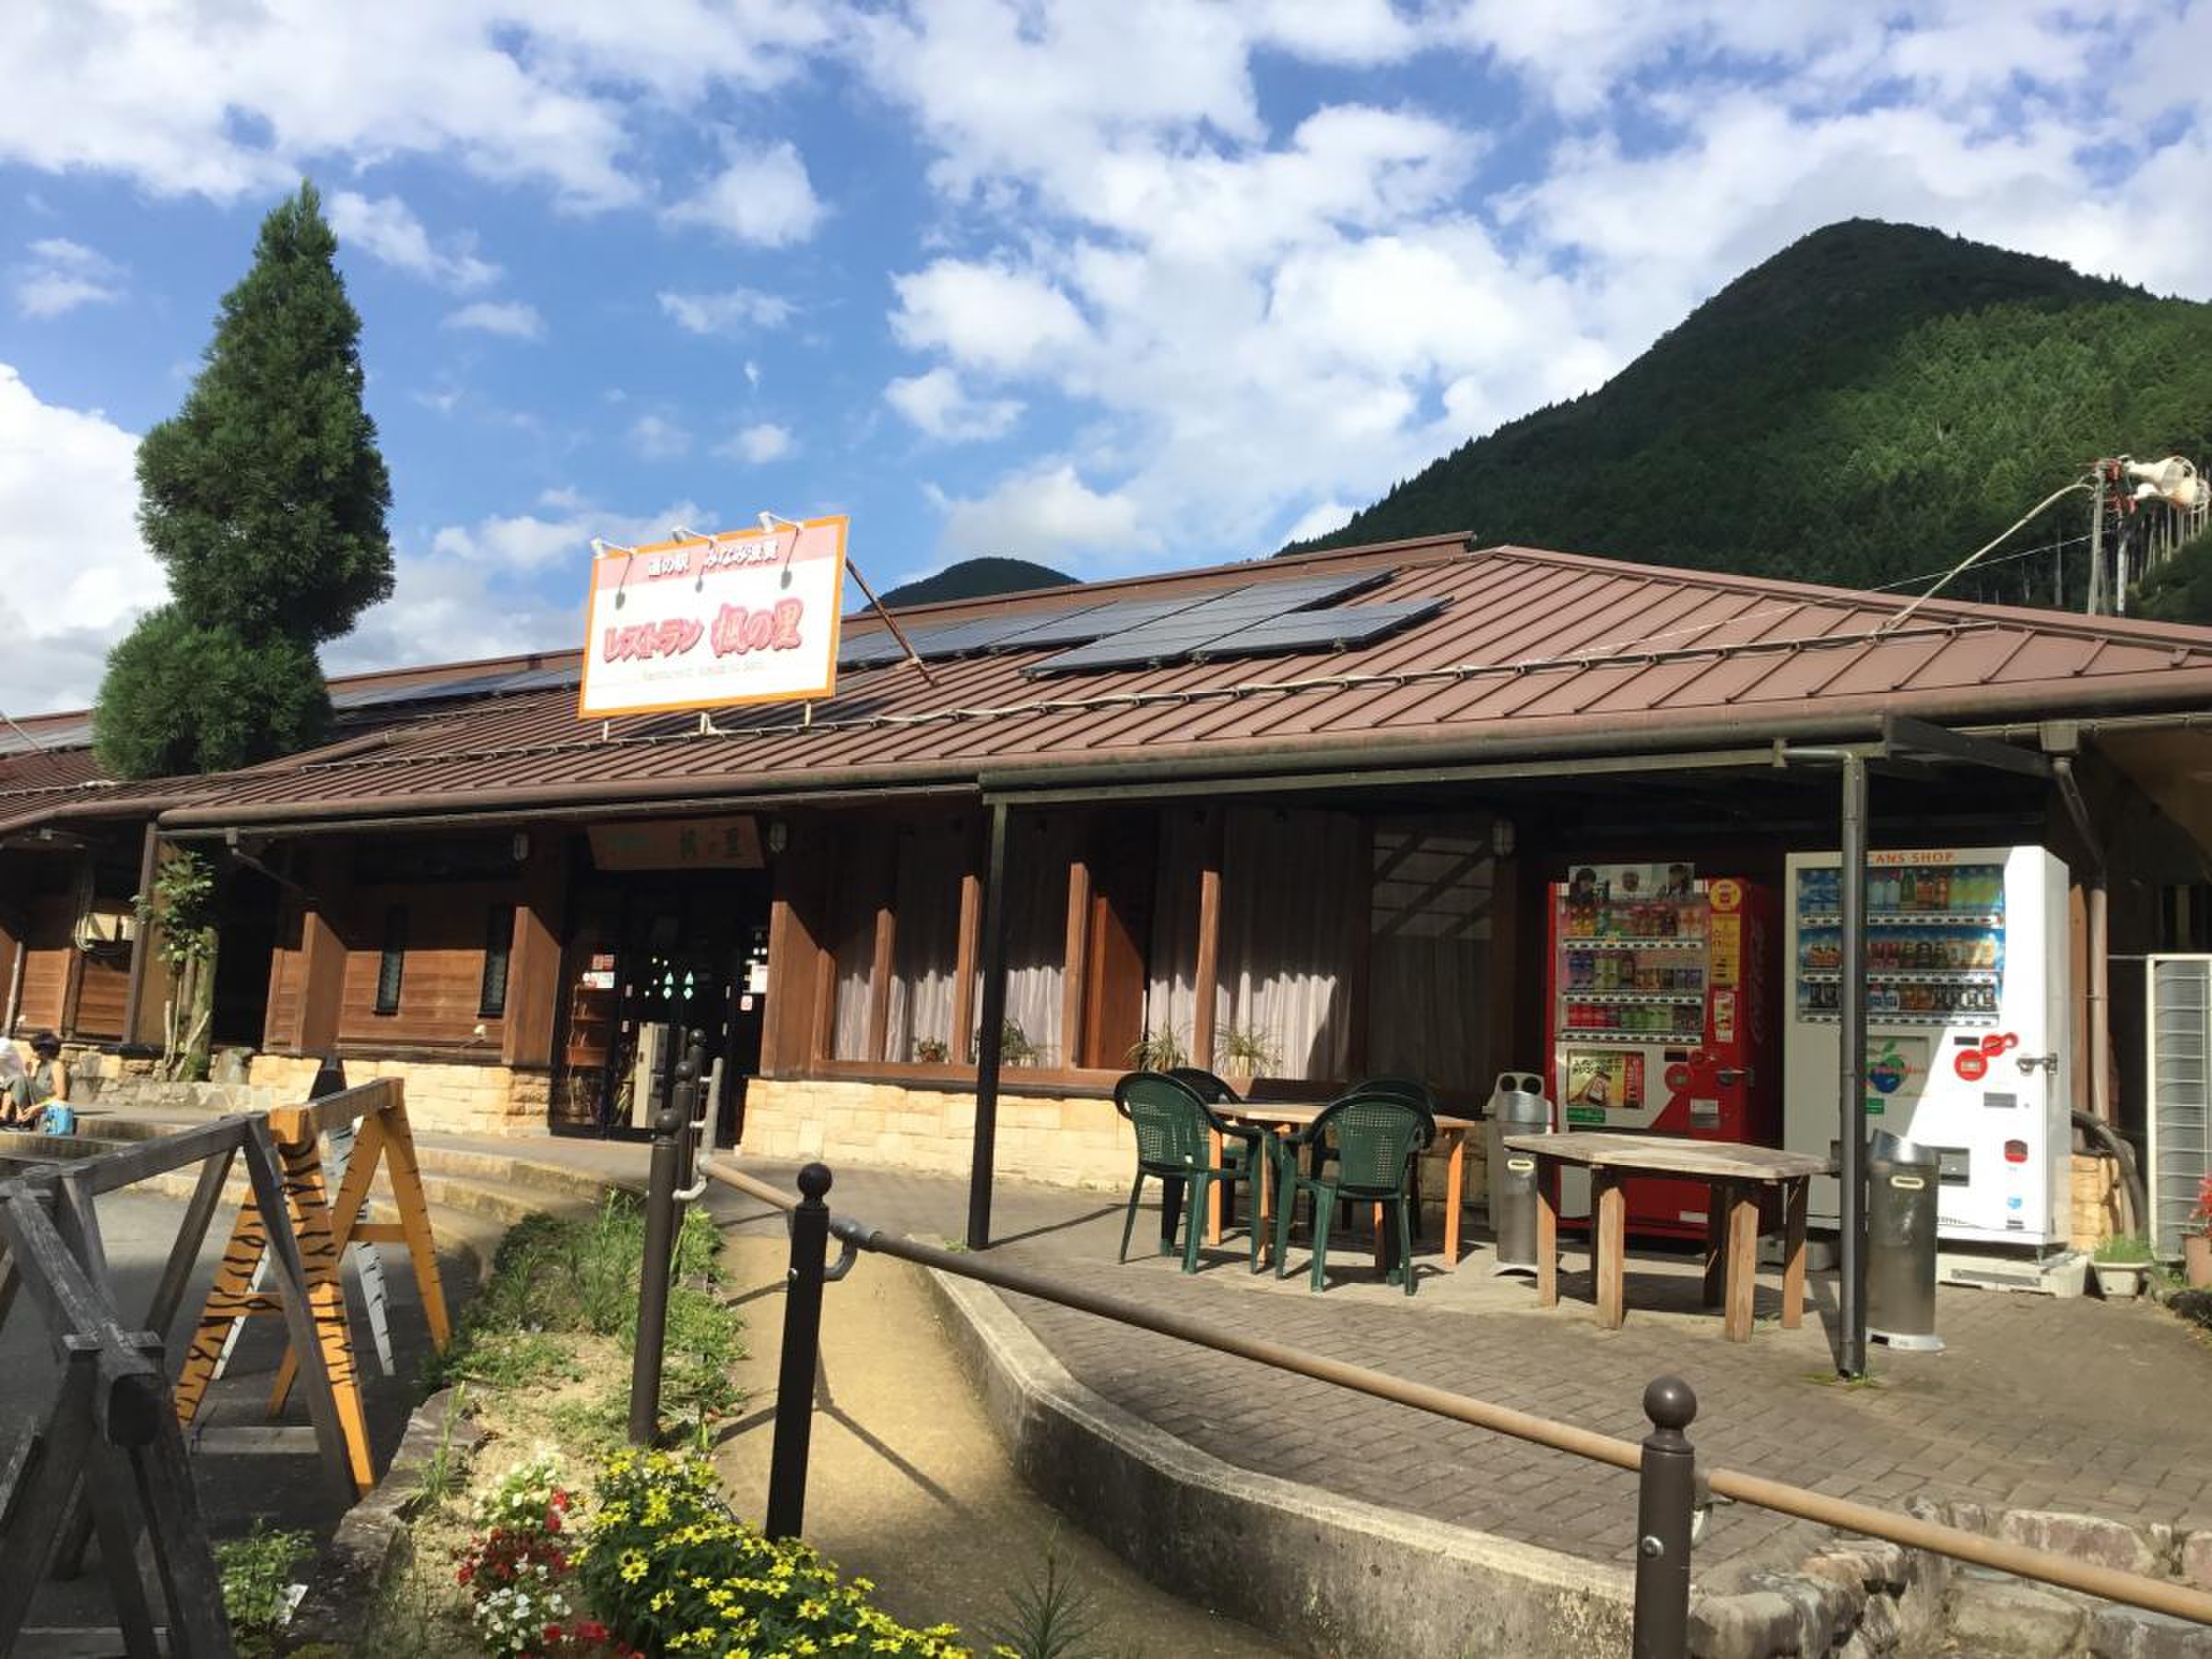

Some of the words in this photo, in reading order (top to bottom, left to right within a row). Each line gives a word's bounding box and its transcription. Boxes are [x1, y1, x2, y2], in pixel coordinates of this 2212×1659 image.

[605, 618, 704, 663] レストラン
[1912, 852, 1954, 864] SHOP
